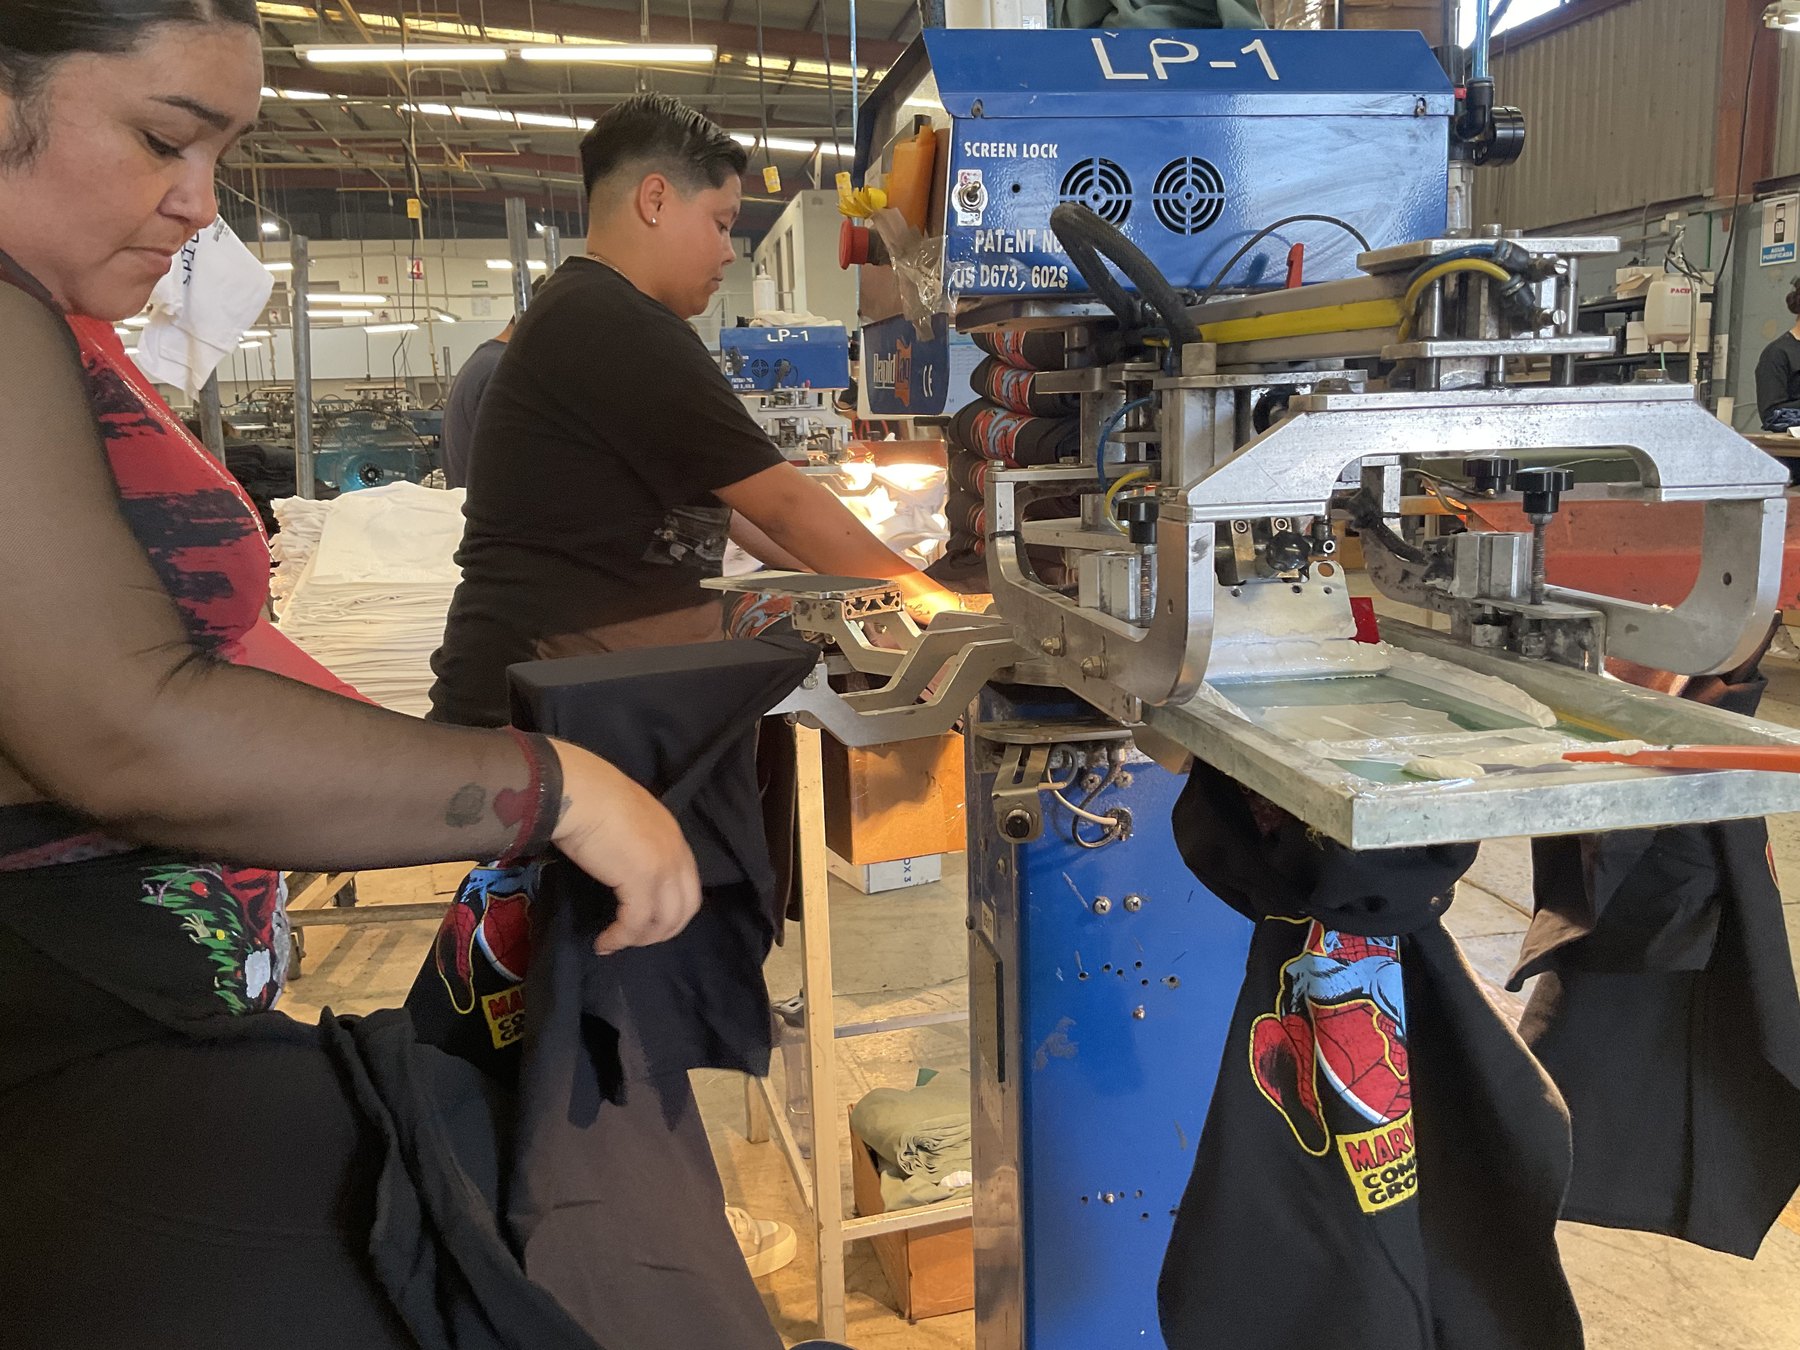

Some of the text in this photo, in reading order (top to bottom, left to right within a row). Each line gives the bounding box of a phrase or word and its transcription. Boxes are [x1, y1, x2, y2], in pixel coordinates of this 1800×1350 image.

[1091, 38, 1280, 81] LP-1
[964, 141, 1059, 159] SCREEN LOCK
[975, 229, 1037, 254] PATENT
[767, 328, 809, 342] LP-1
